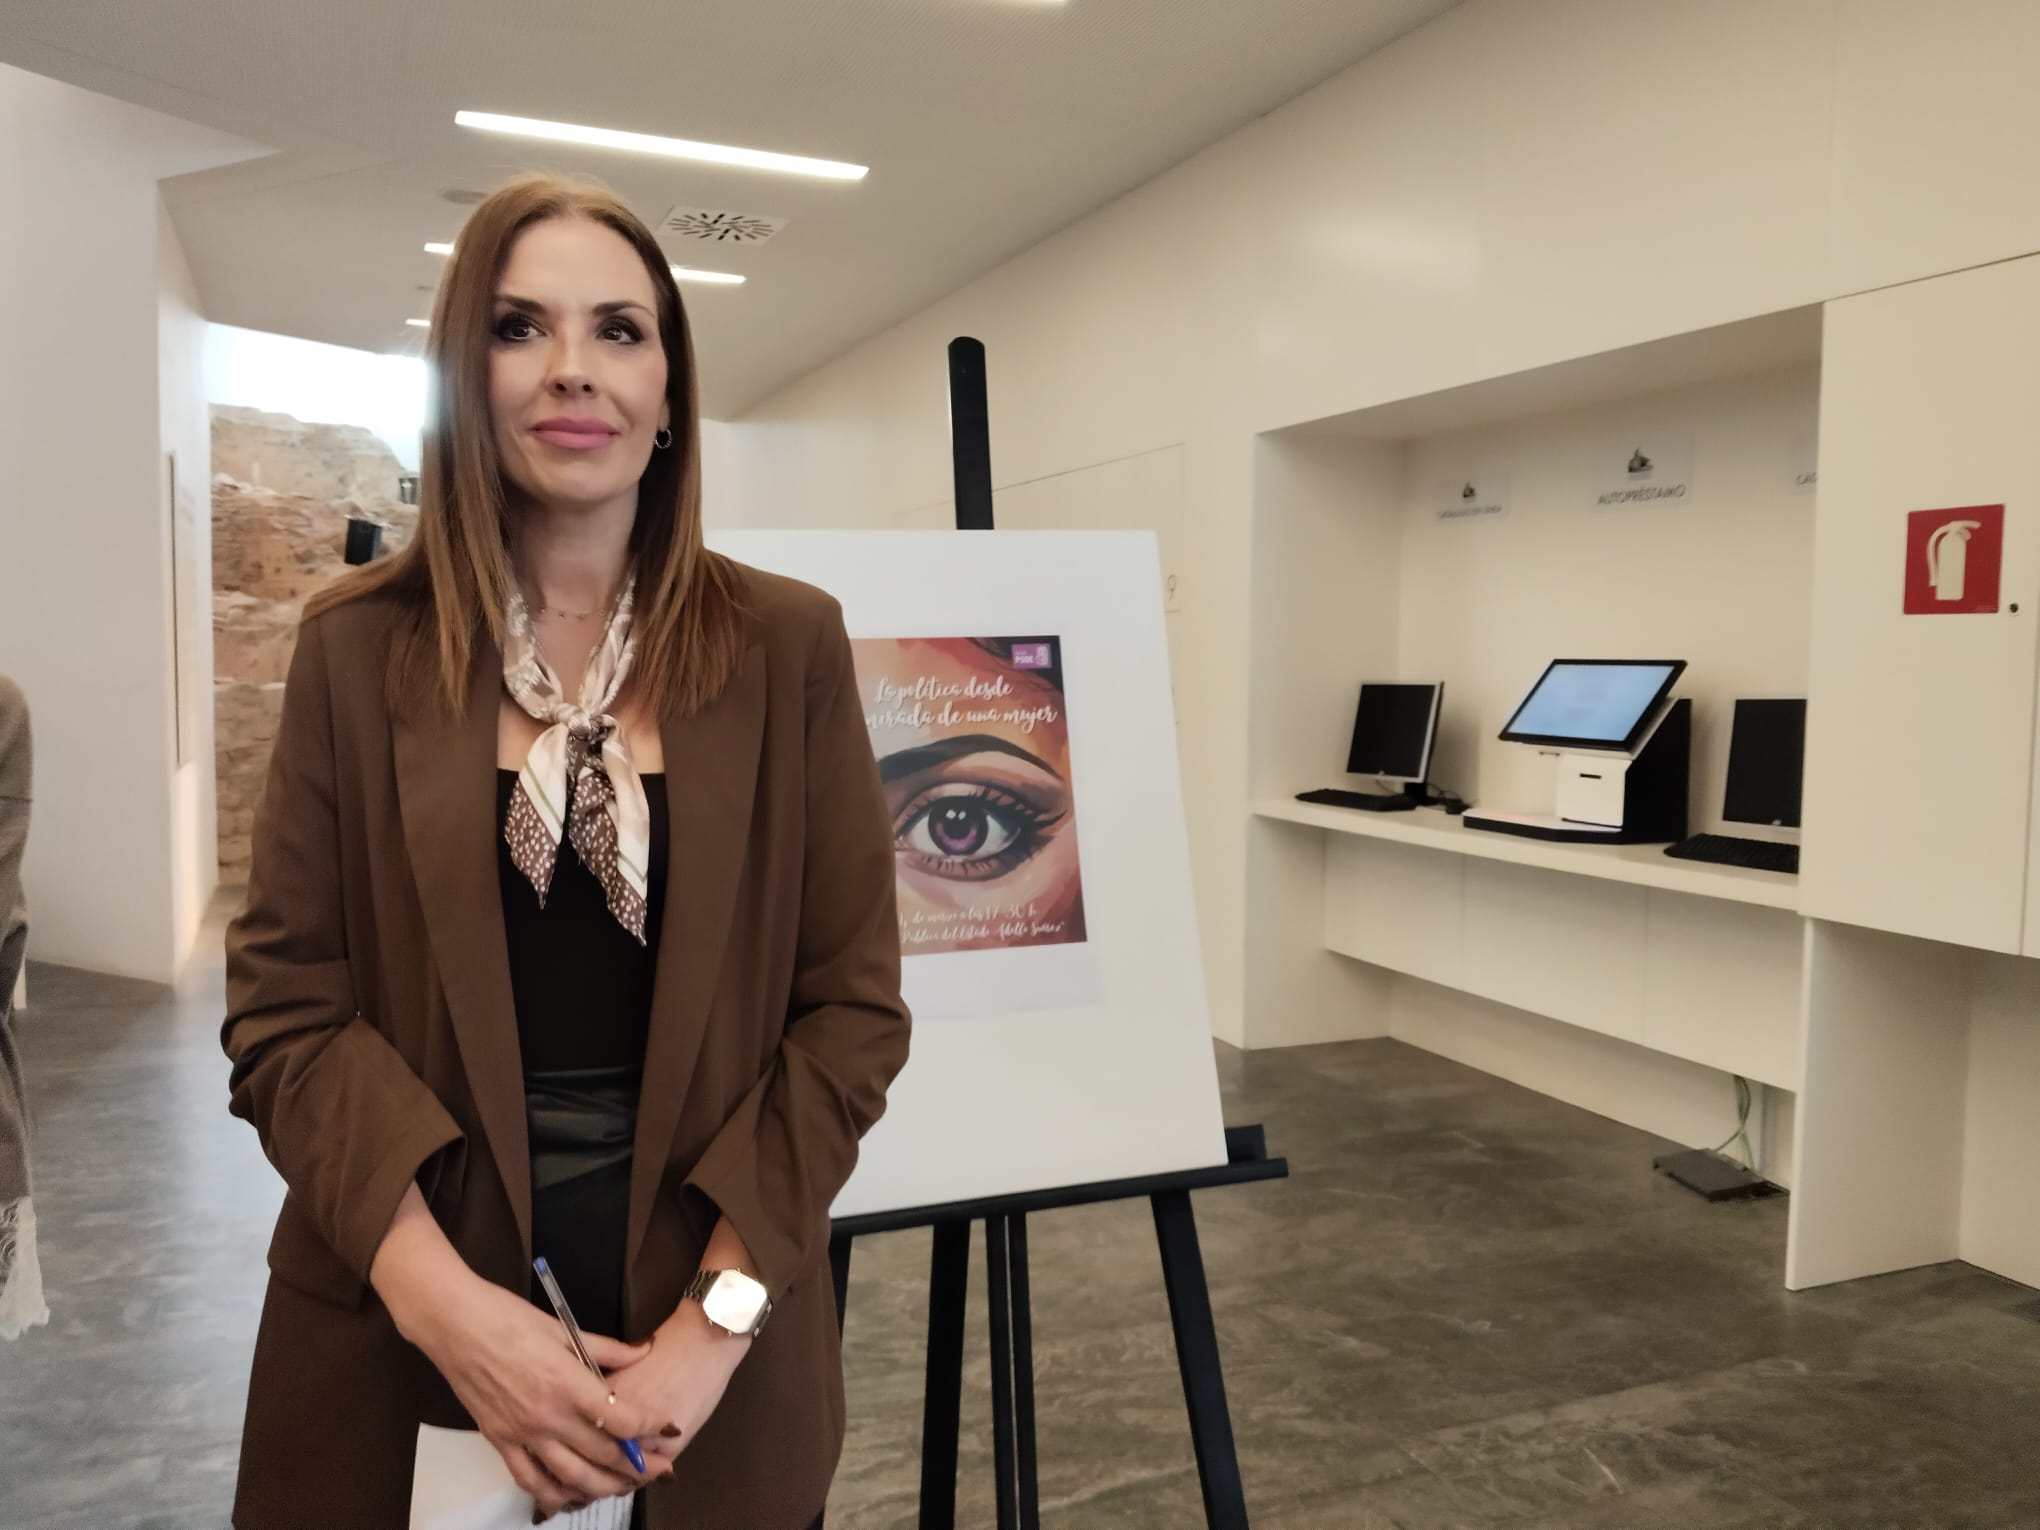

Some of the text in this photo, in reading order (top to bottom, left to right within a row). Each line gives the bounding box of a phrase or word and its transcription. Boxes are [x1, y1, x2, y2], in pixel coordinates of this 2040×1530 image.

[963, 674, 1014, 702] desde
[937, 701, 964, 729] de
[967, 708, 1002, 725] una
[1003, 704, 1059, 736] mujer
